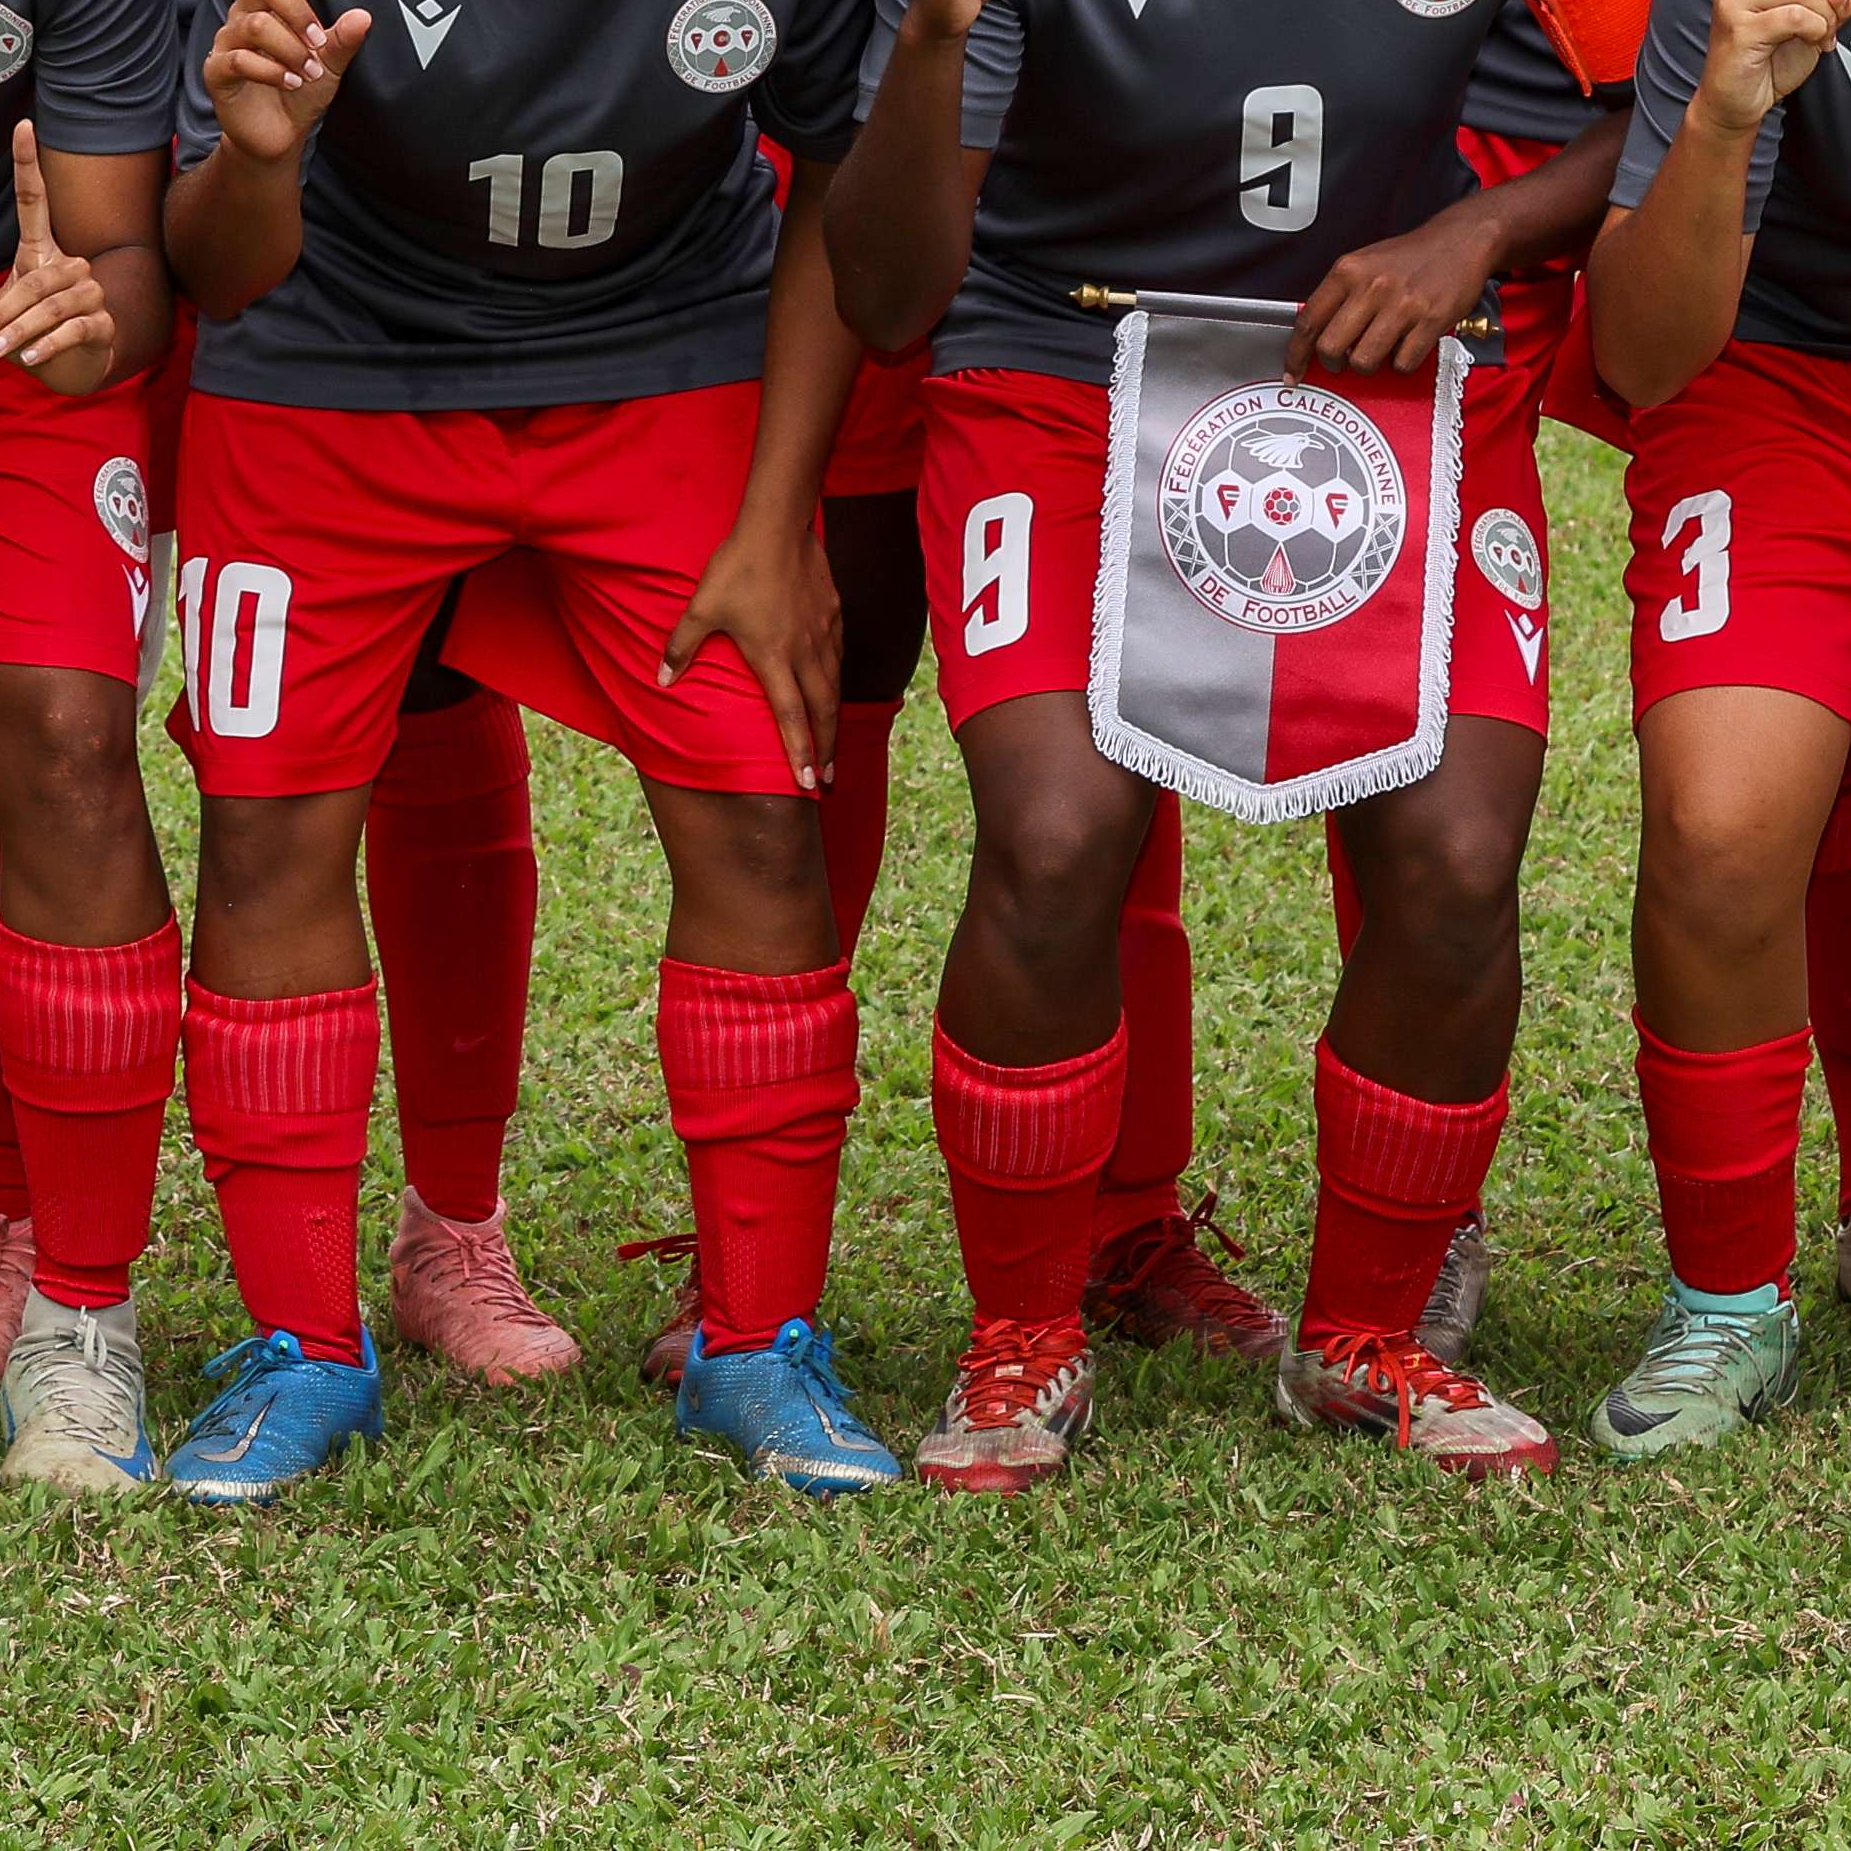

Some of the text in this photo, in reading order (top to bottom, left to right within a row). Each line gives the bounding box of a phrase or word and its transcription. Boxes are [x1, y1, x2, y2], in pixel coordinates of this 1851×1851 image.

[683, 68, 759, 90] DE FOOTBALL
[467, 149, 624, 250] 10
[1239, 83, 1325, 232] 9
[1168, 387, 1396, 506] FÉDÉRATION CALÉDONIENNE
[961, 492, 1034, 657] 9
[1199, 574, 1358, 626] DE FOOTBALL
[1659, 488, 1734, 643] 3
[175, 556, 293, 739] 10
